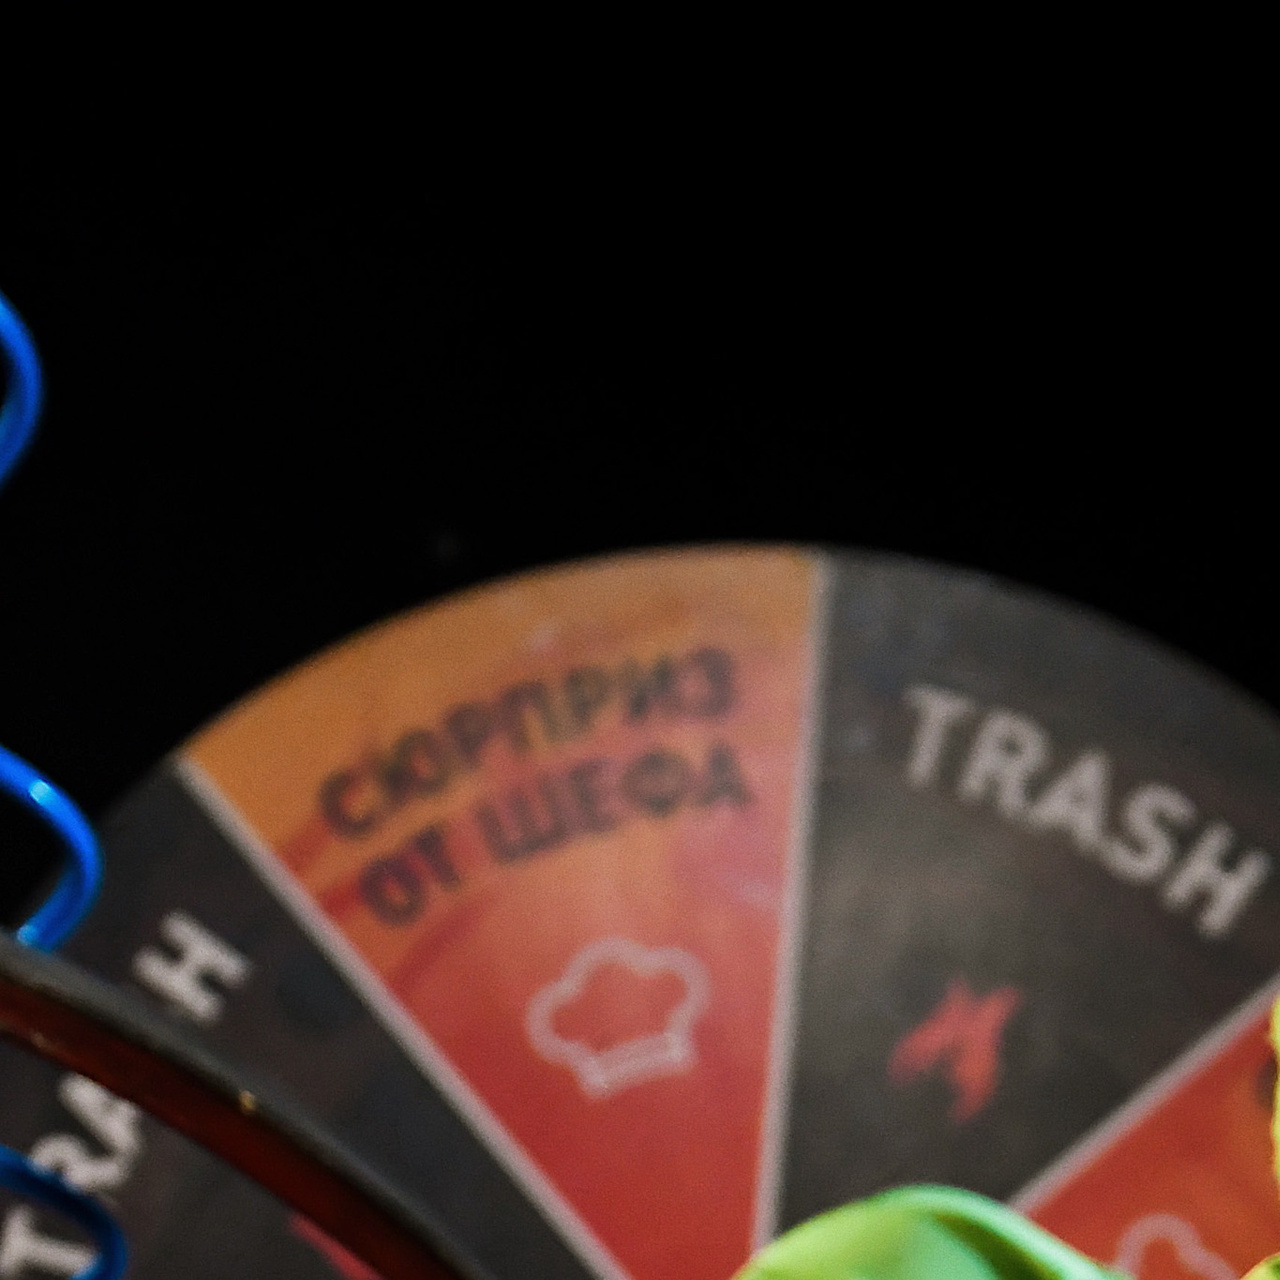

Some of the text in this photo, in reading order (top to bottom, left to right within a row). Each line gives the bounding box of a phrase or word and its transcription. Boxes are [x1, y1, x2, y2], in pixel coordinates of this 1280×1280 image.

[319, 648, 736, 845] СЮРПРИЗ
[357, 742, 752, 928] ОТ ШЕФА
[900, 683, 1273, 936] TRASH
